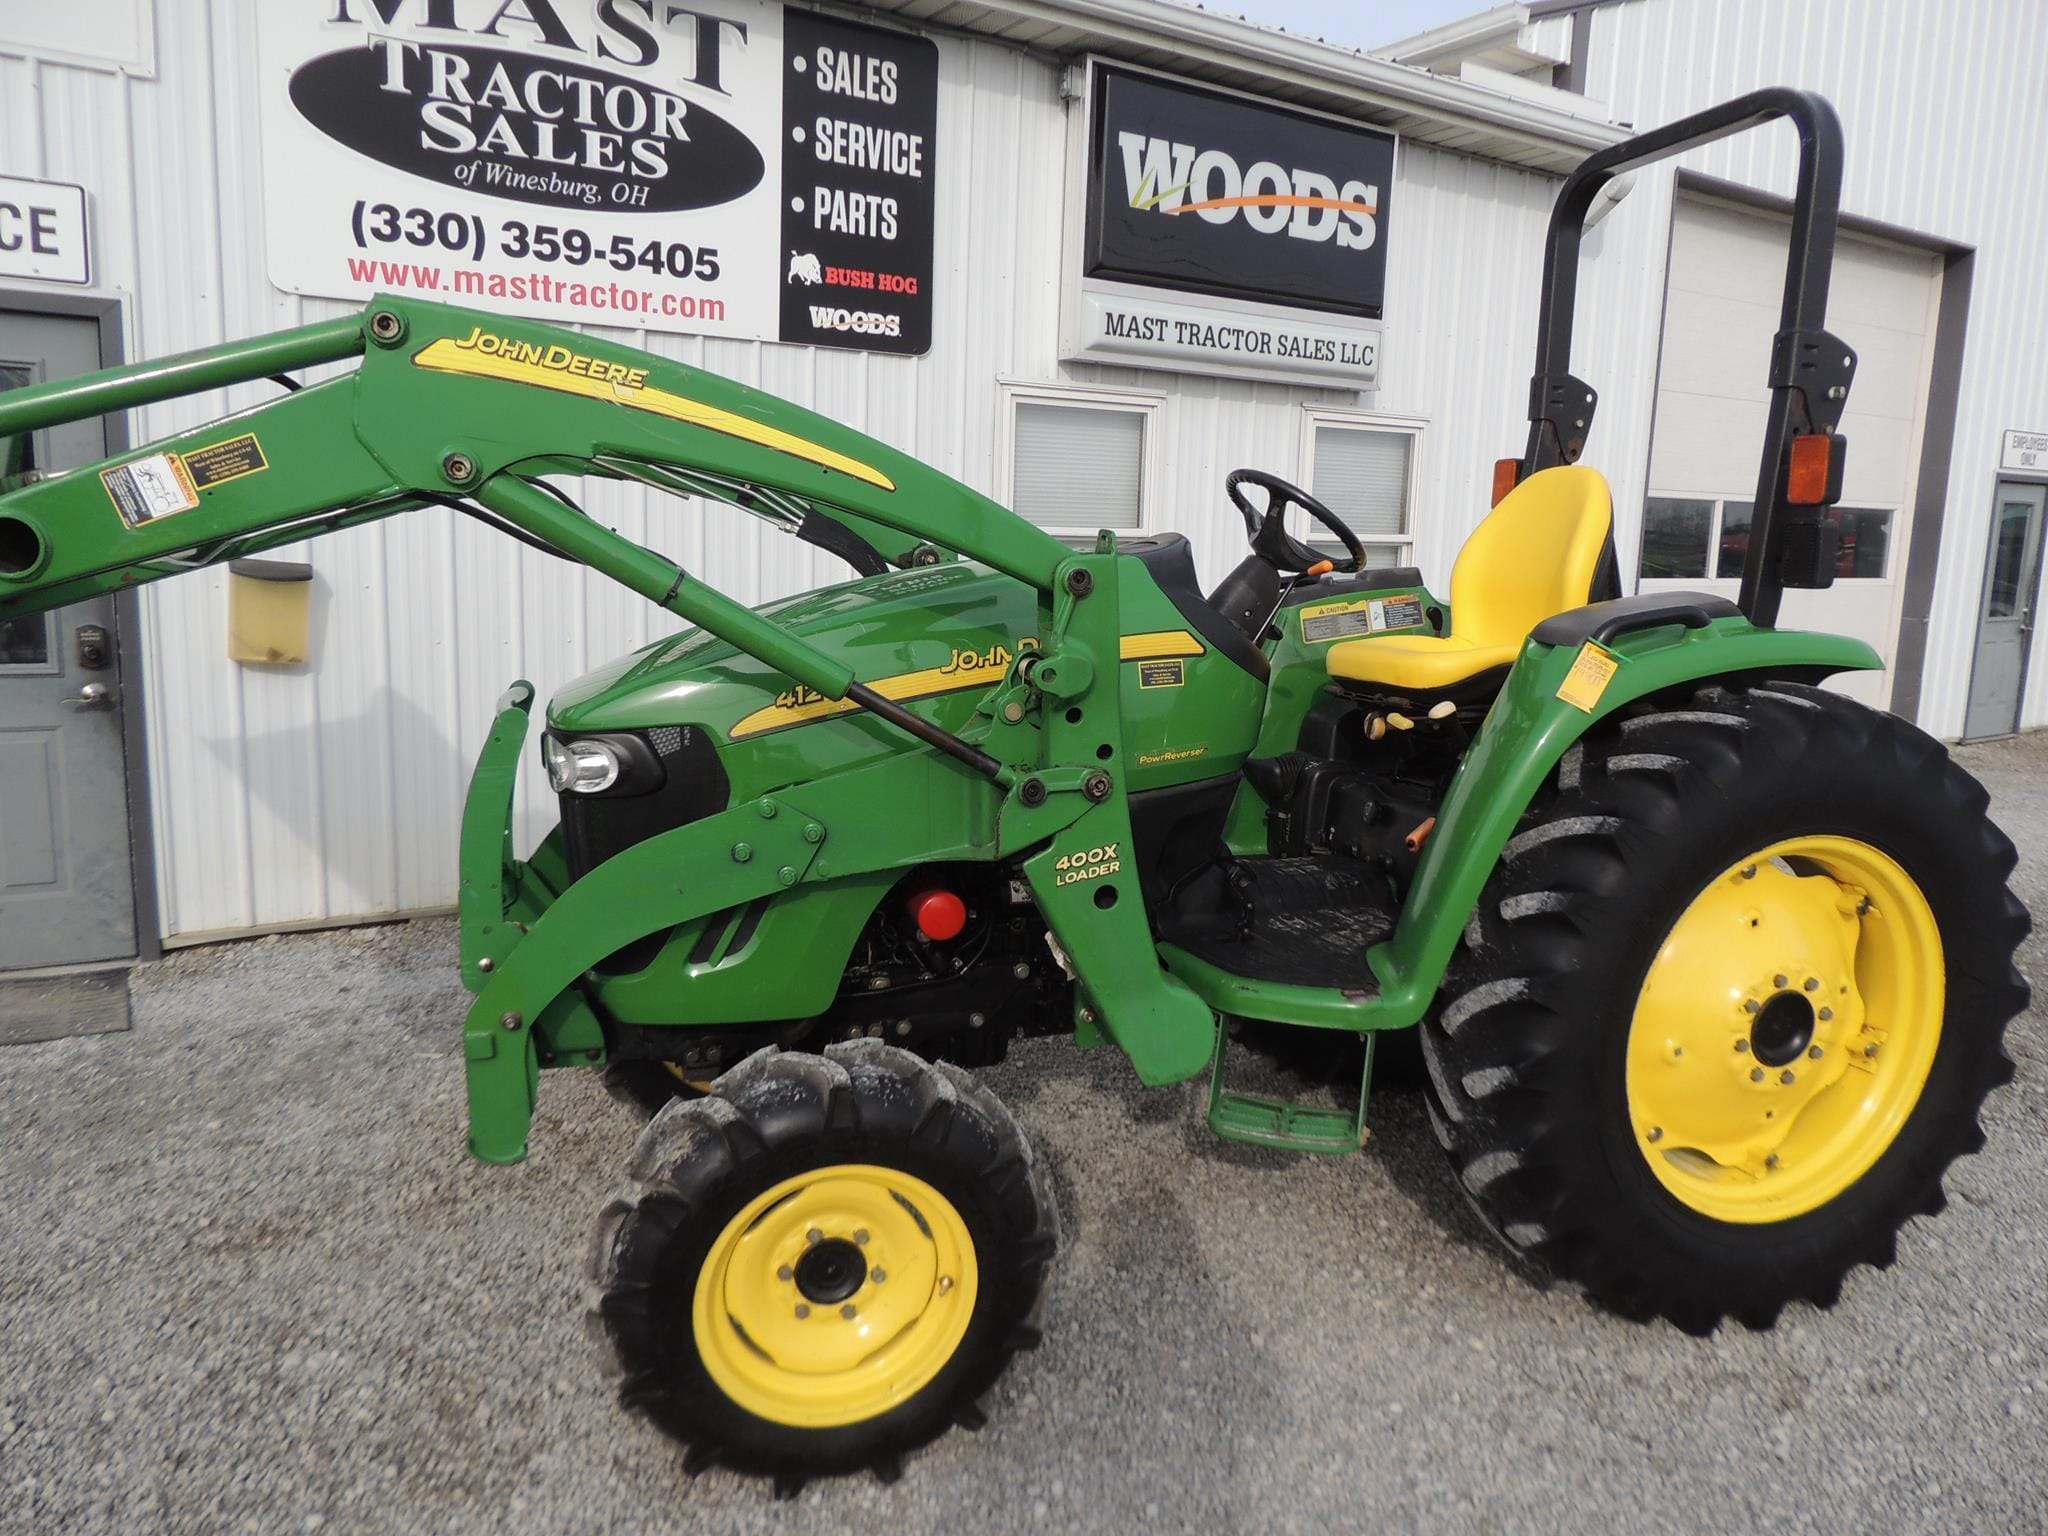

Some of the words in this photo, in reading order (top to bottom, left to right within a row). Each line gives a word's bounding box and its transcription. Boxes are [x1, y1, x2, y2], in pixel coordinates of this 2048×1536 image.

[367, 33, 692, 142] TRACTOR
[817, 47, 898, 104] SALES
[421, 101, 669, 178] SALES
[815, 117, 923, 177] SERVICE
[454, 160, 482, 186] of
[485, 162, 602, 204] Winesburg,
[611, 183, 650, 206] OH
[1118, 130, 1379, 250] WOODS
[814, 186, 898, 240] PARTS
[352, 200, 487, 261] (330)
[500, 221, 721, 282] 359-5405
[348, 258, 726, 321] www.masttractor.com
[825, 266, 875, 290] BUSH
[878, 273, 918, 295] HOG
[809, 306, 901, 336] WOODS
[1105, 312, 1168, 342] MAST
[1175, 321, 1272, 353] TRACTOR
[1277, 334, 1335, 362] SALES
[1340, 342, 1374, 366] LLC
[455, 327, 544, 365] JOHN
[542, 345, 649, 389] DEERE
[174, 465, 196, 501] WARNING
[1139, 747, 1205, 764] PowrReverser
[1056, 843, 1118, 870] 400X
[1056, 861, 1120, 886] LOADER
